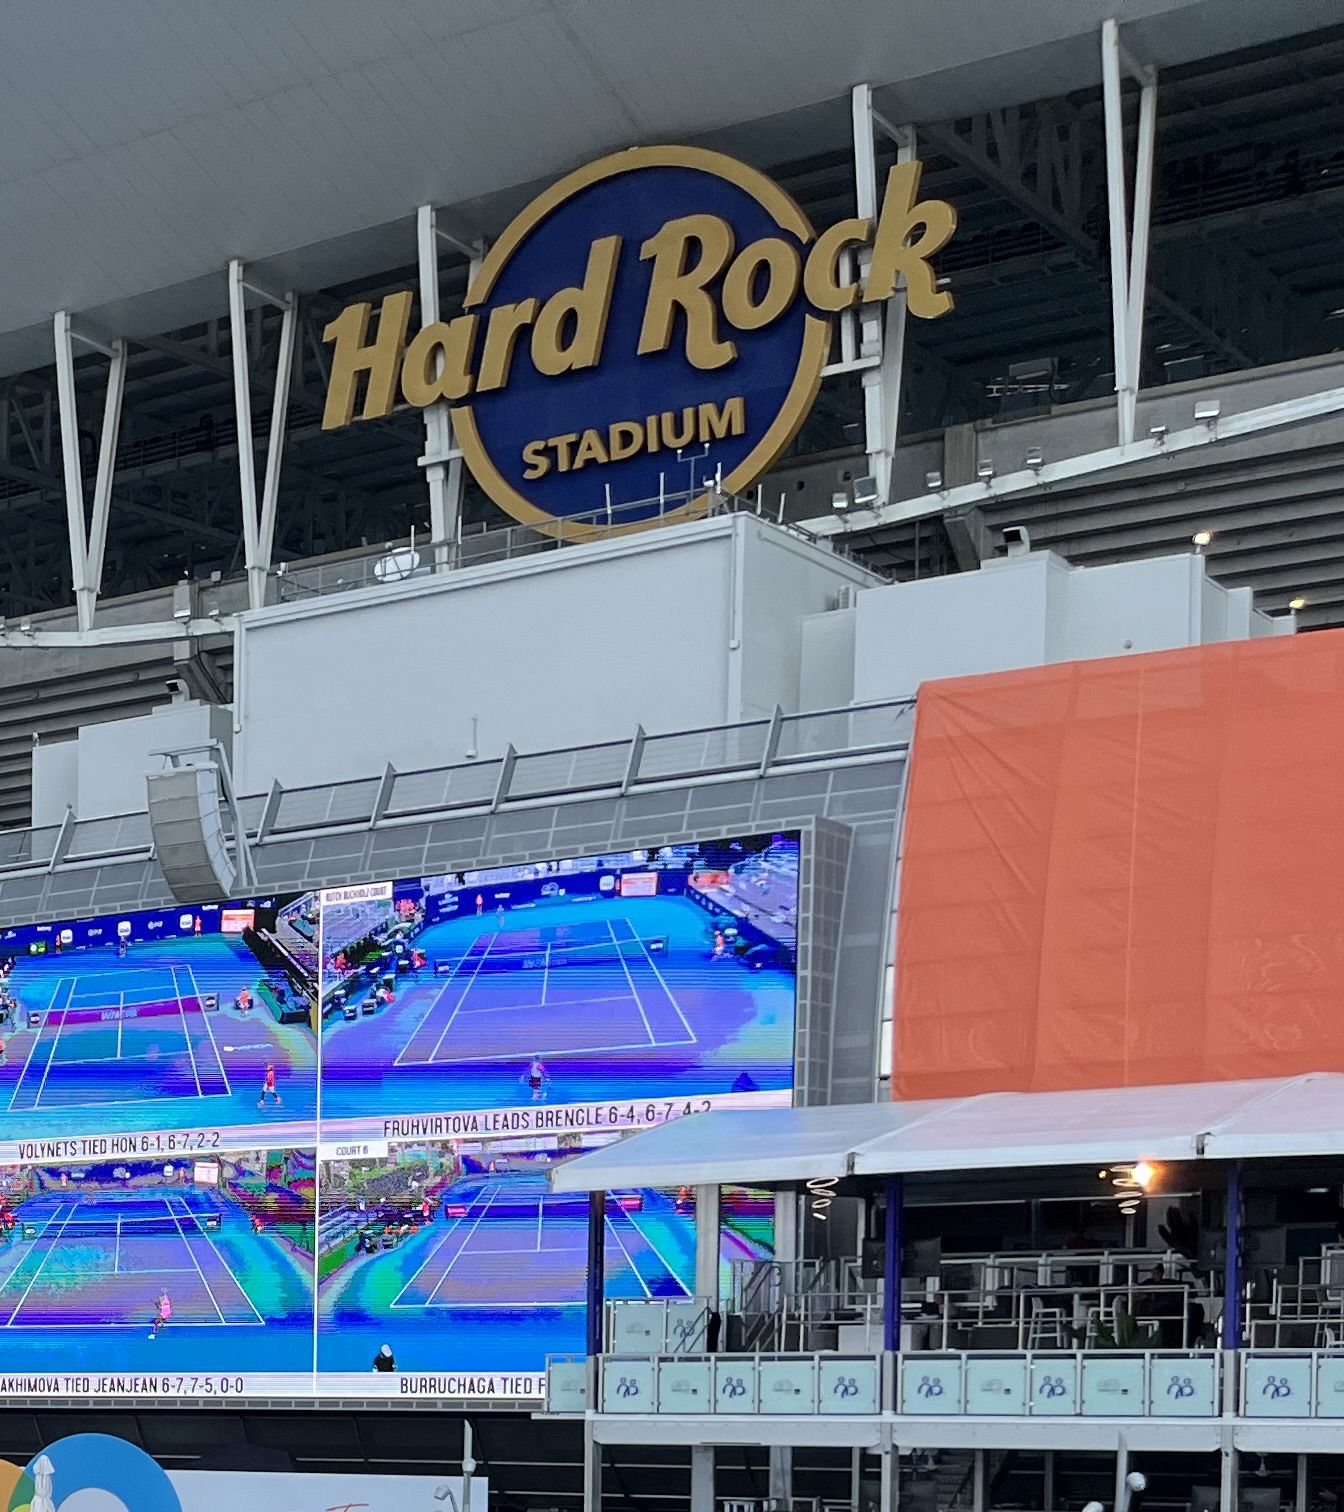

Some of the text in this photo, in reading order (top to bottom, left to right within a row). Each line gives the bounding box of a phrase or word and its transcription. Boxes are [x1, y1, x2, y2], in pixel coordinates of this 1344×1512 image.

[322, 160, 959, 431] Hard Rock
[522, 396, 746, 480] STADIUM
[383, 1115, 479, 1137] FRUHVIRTOVA
[484, 1112, 530, 1132] LEADS
[535, 1107, 603, 1129] BRENGLE
[608, 1105, 641, 1126] 6-4,
[18, 1140, 78, 1160] VOLYNETS
[82, 1138, 108, 1156] TIED
[111, 1138, 137, 1153] HON
[197, 1131, 220, 1148] 2-2
[64, 1377, 89, 1393] TIED
[94, 1377, 157, 1393] JEANJEAN
[220, 1376, 244, 1393] 0-0
[400, 1377, 495, 1394] BURRUCHAGA
[501, 1377, 532, 1394] TIED
